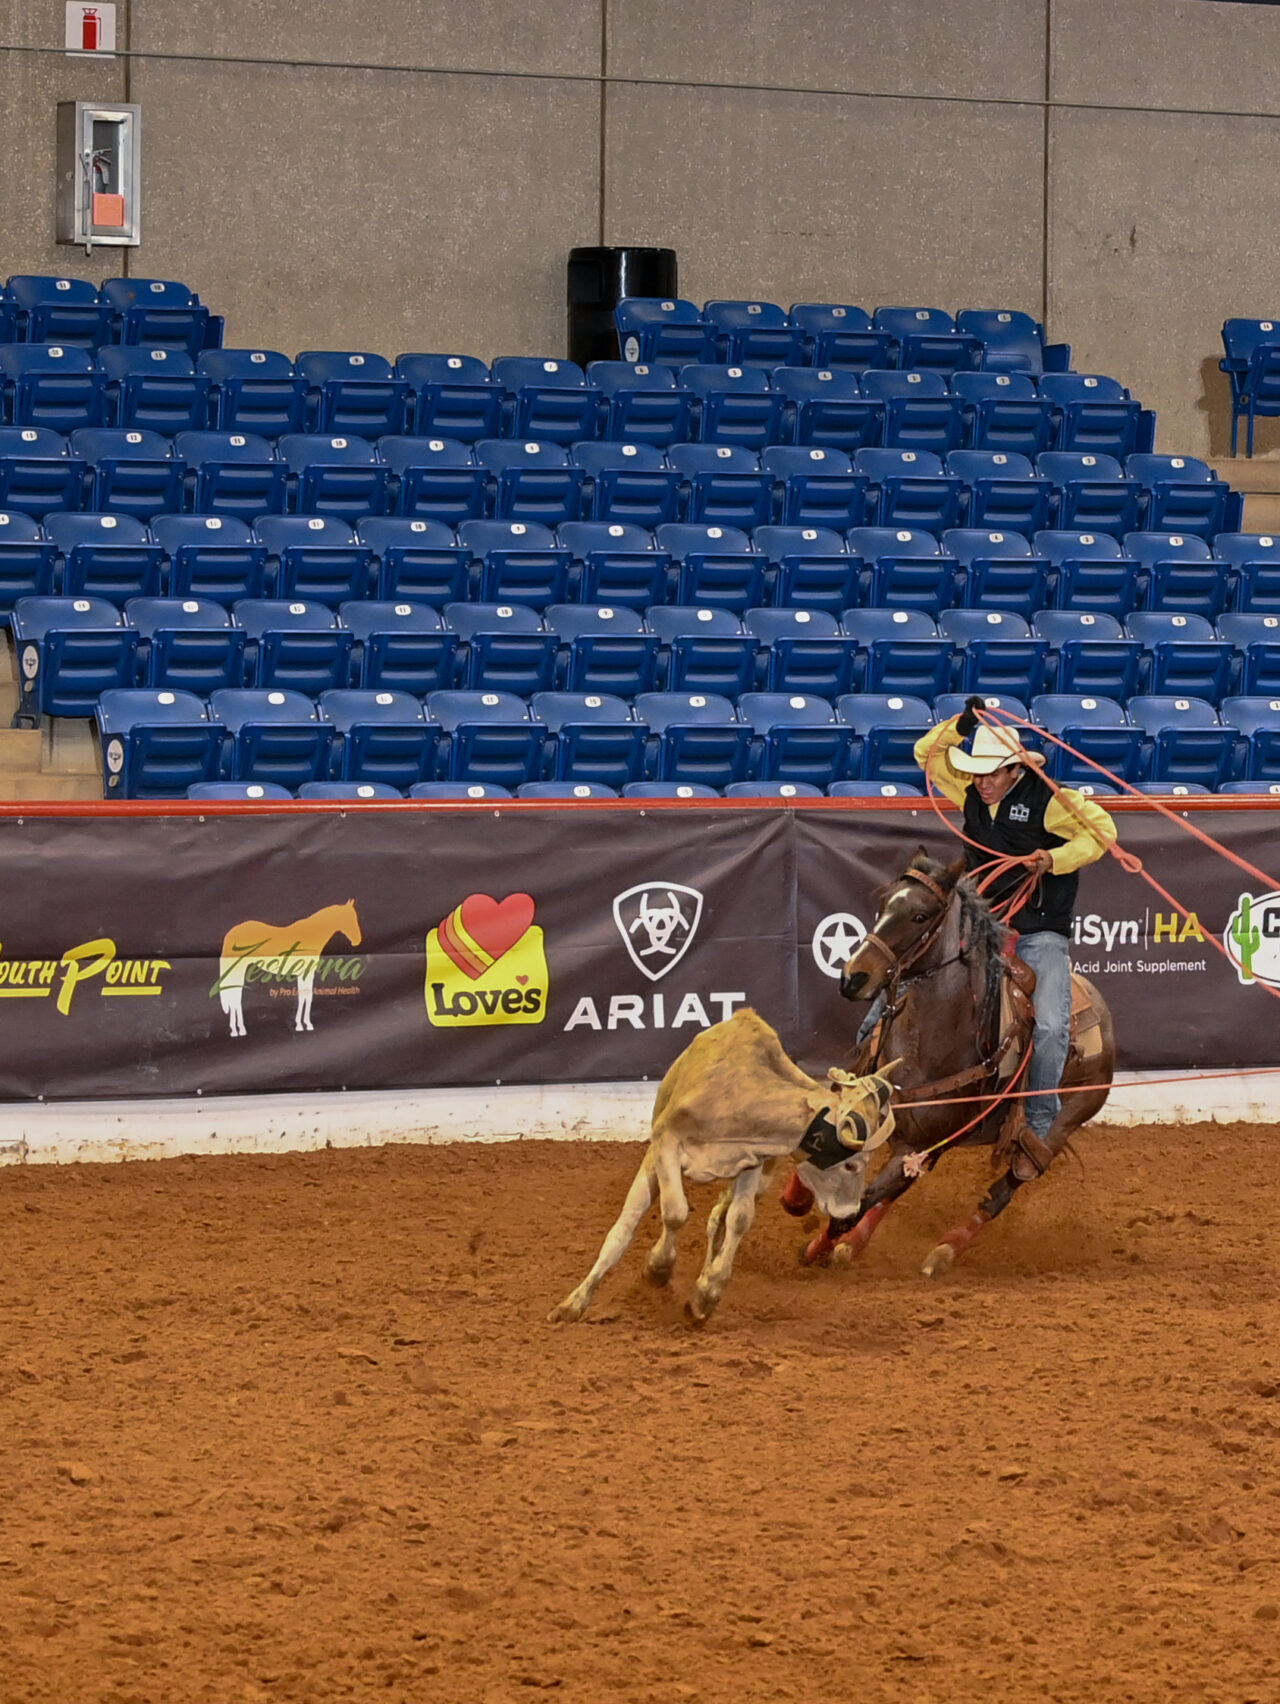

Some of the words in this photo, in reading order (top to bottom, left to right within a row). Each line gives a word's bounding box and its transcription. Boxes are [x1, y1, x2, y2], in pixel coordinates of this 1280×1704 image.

[1153, 912, 1205, 943] HA
[0, 949, 57, 985] OUTH
[57, 938, 172, 1016] POINT
[209, 938, 366, 998] Zesterra
[1073, 961, 1100, 973] Acid
[1104, 960, 1133, 972] Joint
[1137, 959, 1206, 973] Supplement
[563, 992, 746, 1031] ARIAT
